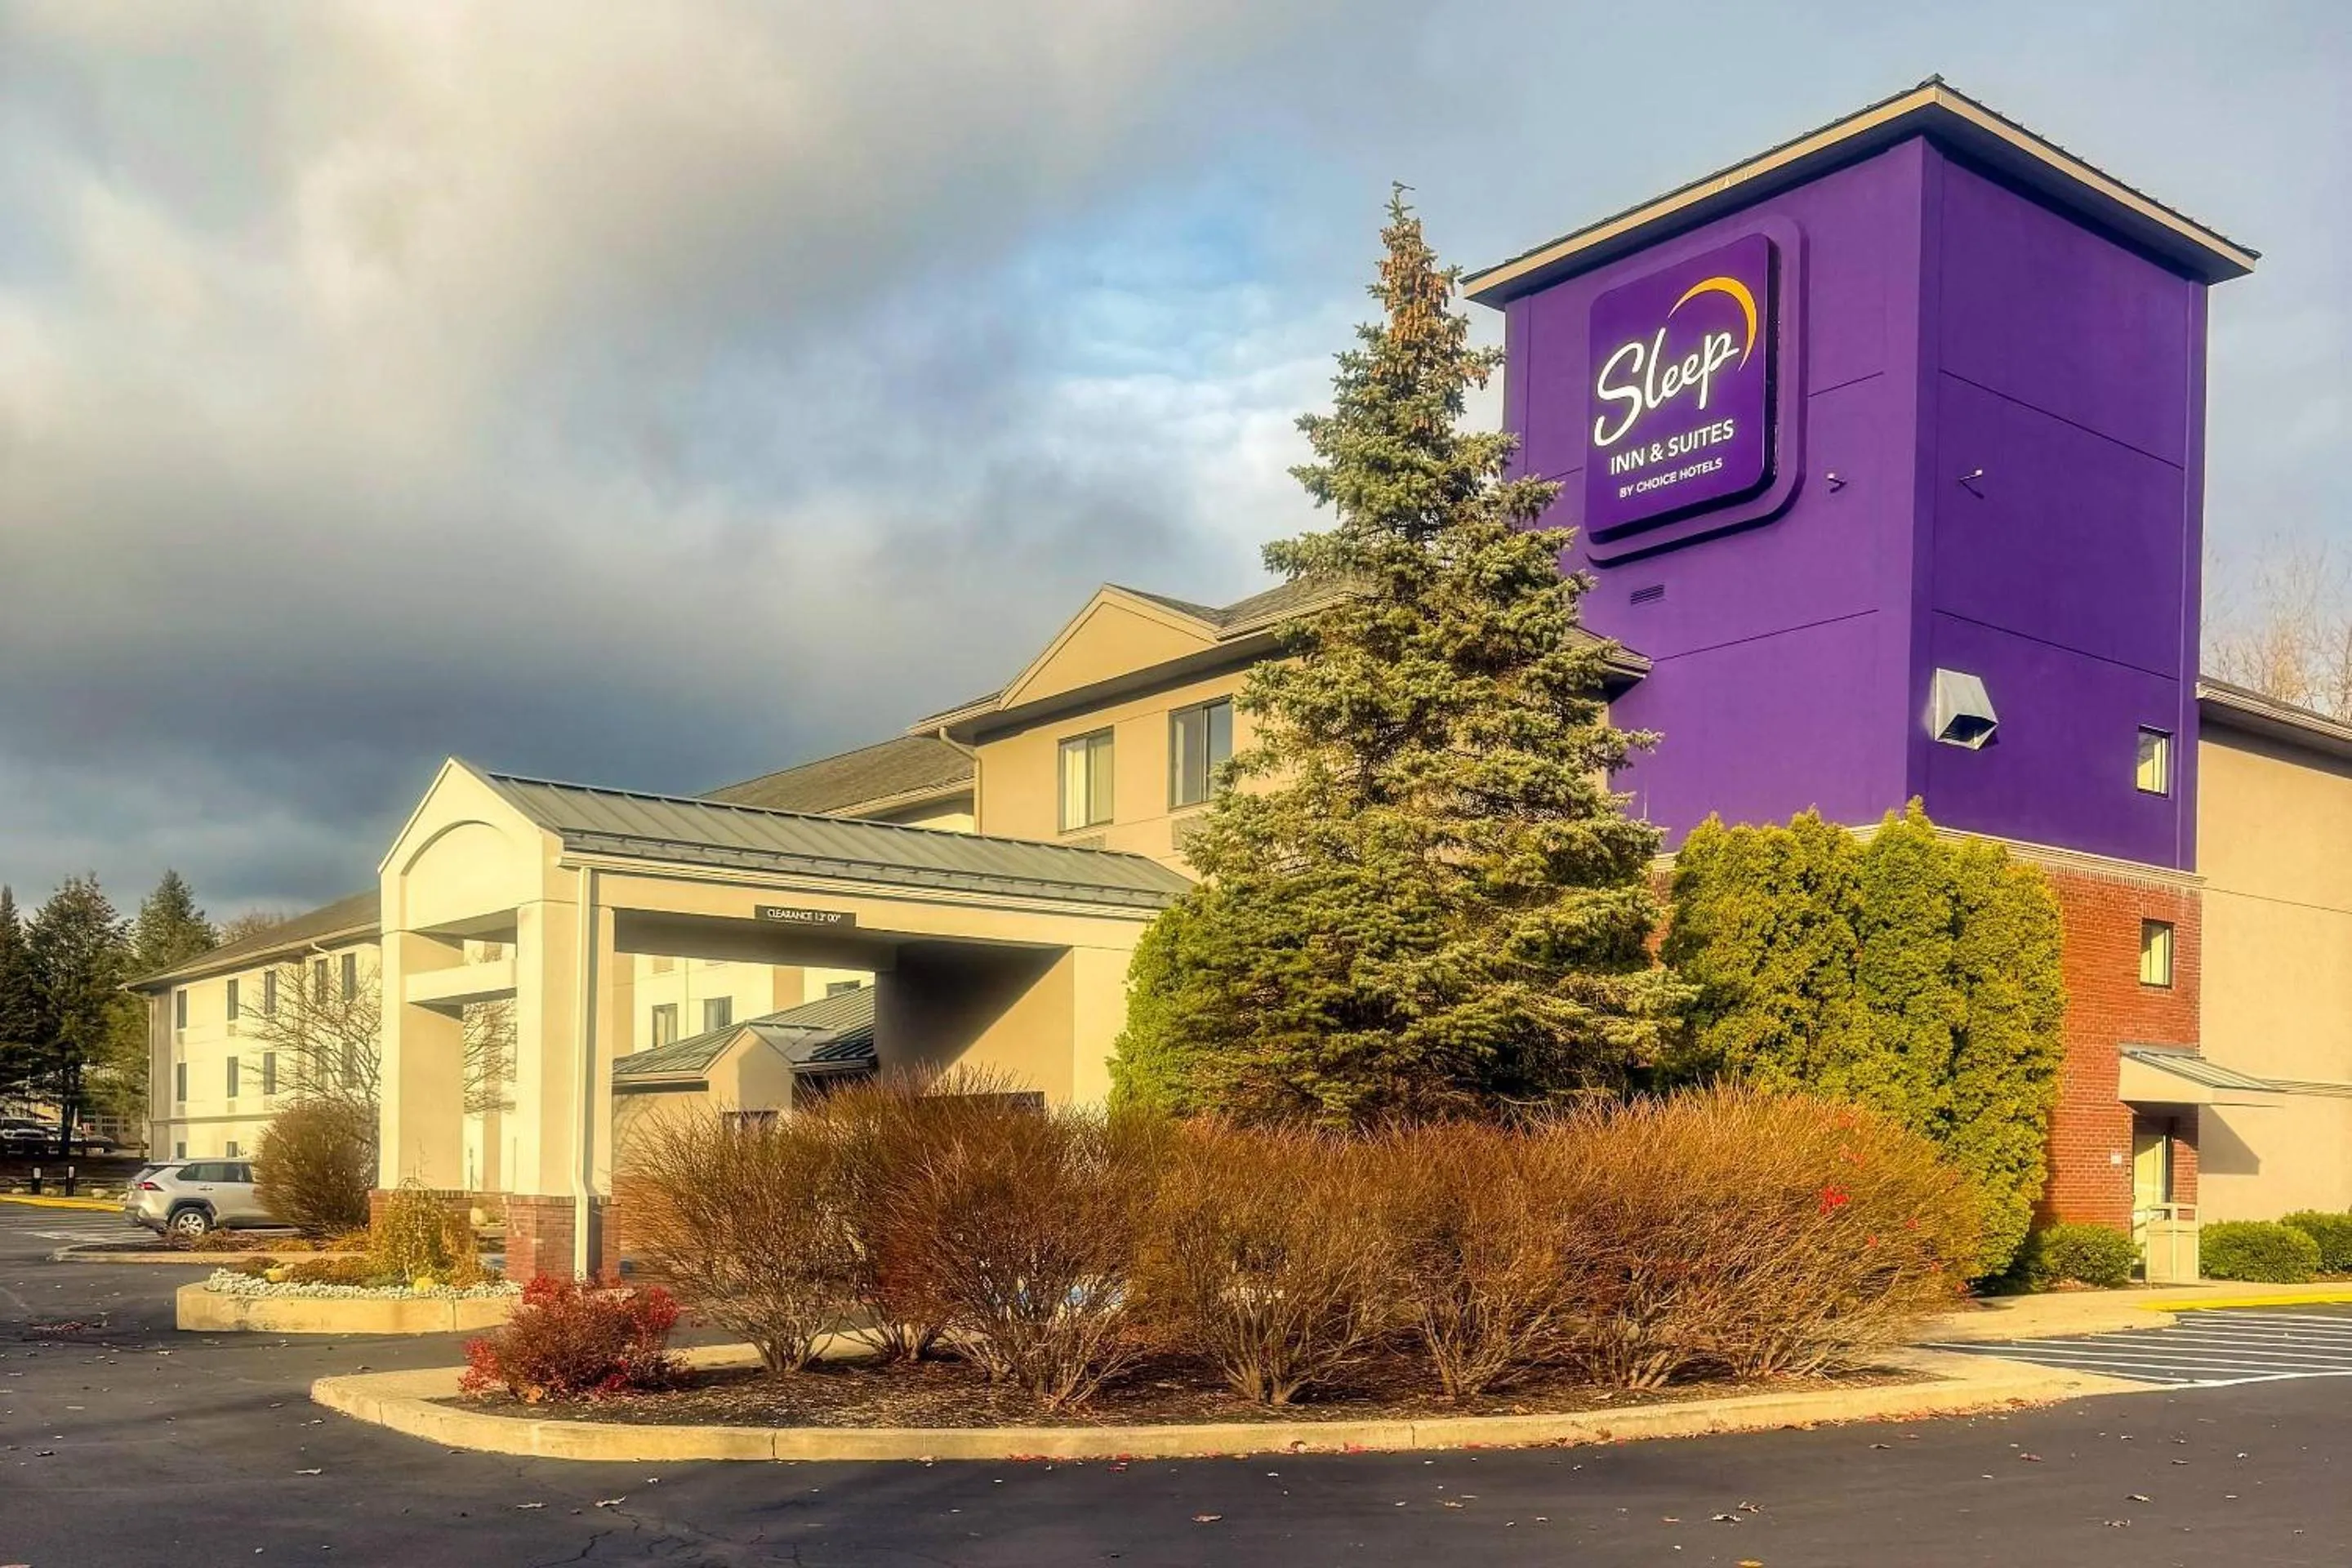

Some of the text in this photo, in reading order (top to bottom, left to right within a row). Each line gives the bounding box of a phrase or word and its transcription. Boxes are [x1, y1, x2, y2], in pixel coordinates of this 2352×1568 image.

[1593, 327, 1740, 447] Sleep
[1610, 418, 1735, 475] INN & SUITES
[1619, 457, 1723, 498] BY CHOICE HOTELS
[766, 908, 813, 921] CLEARANCE
